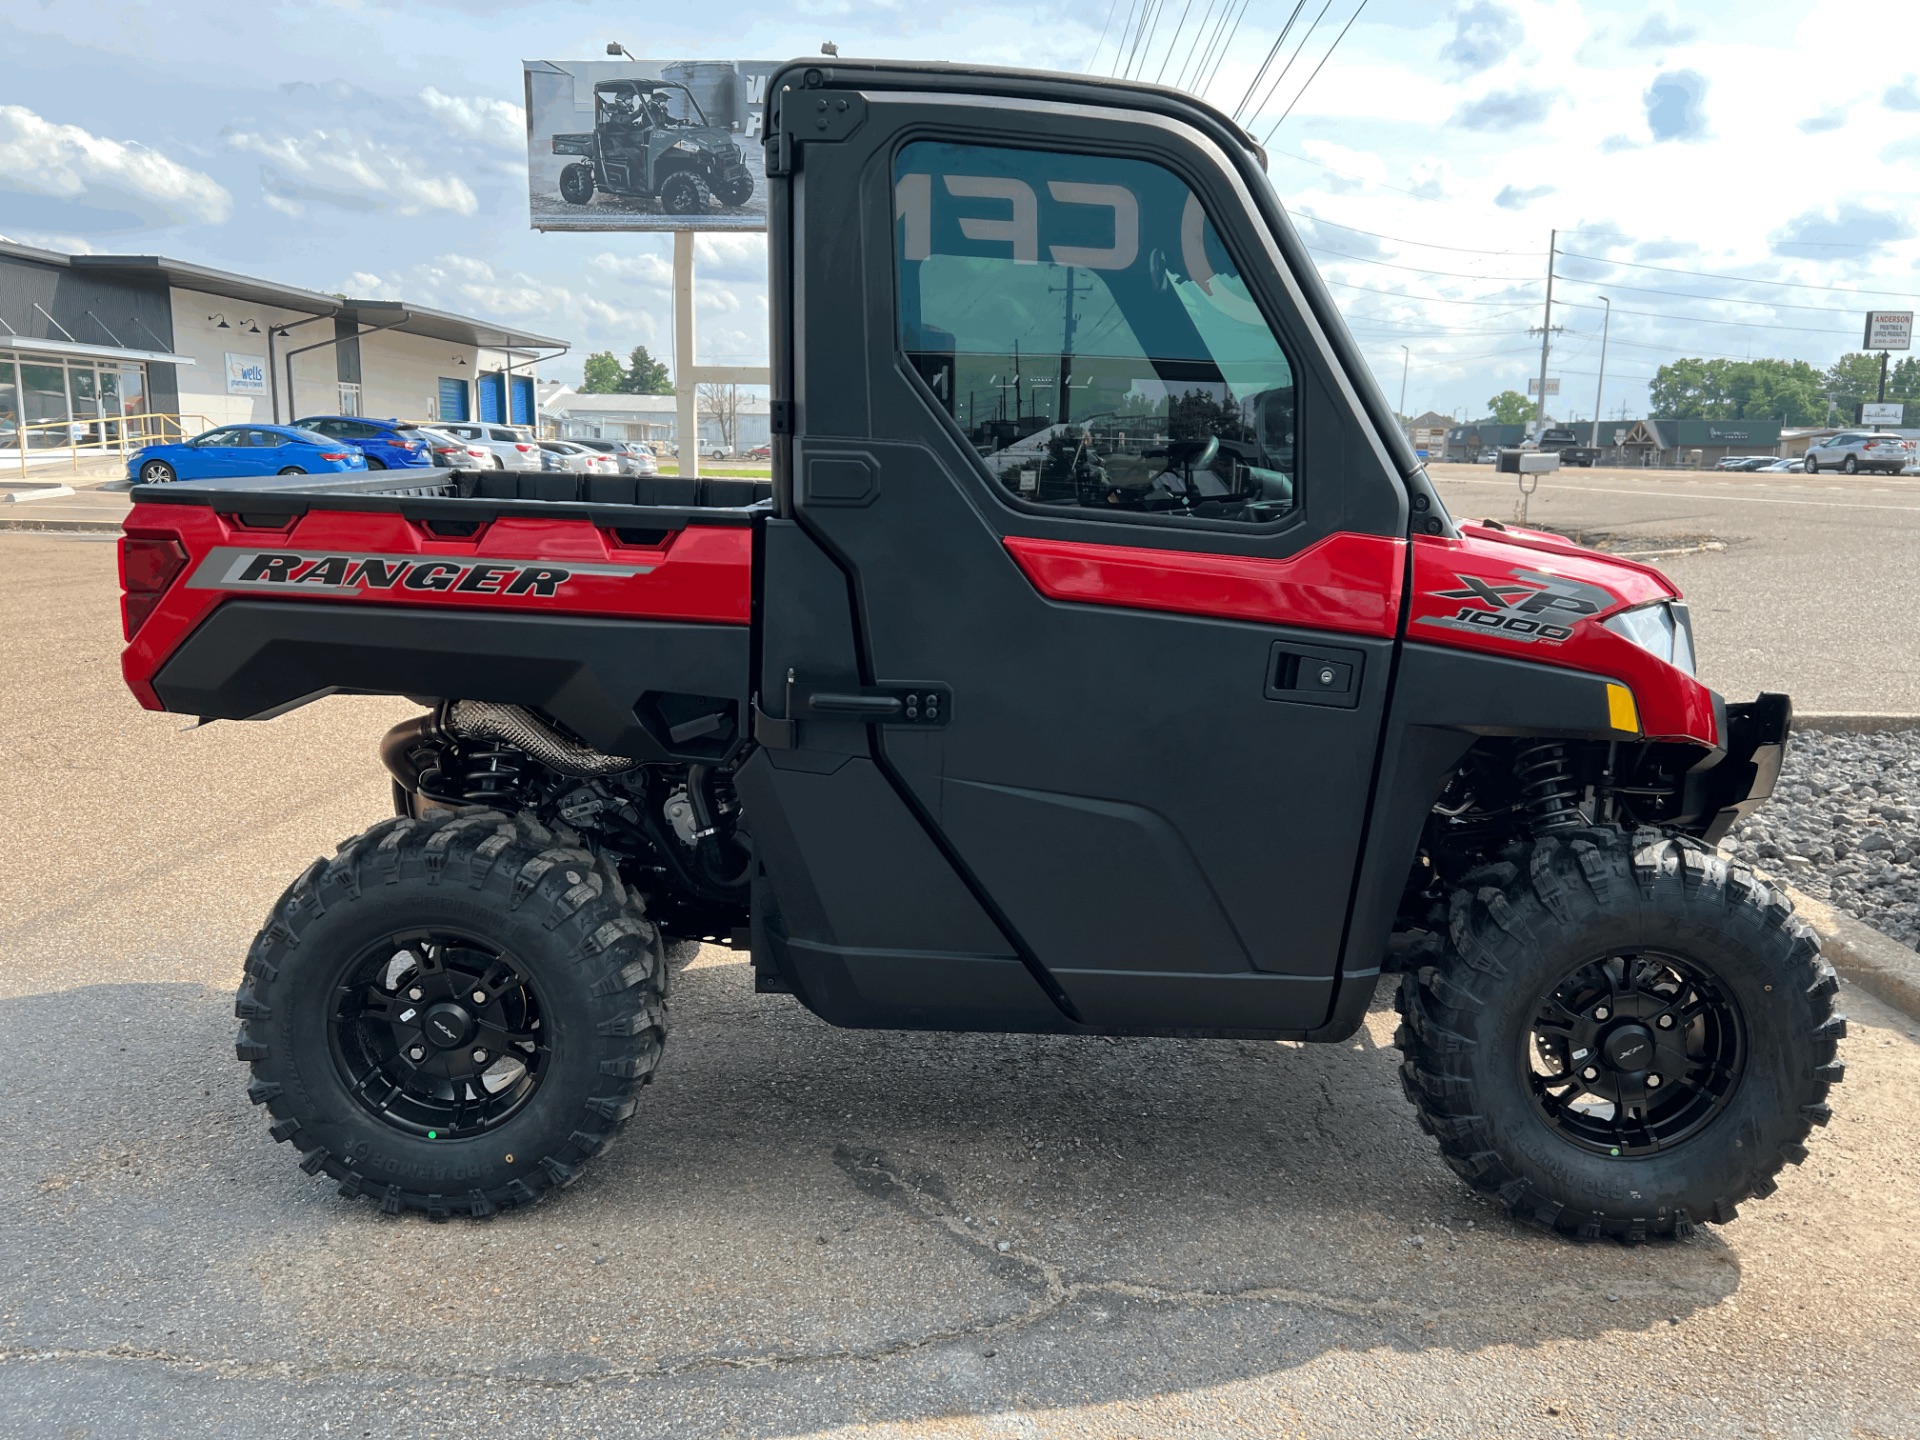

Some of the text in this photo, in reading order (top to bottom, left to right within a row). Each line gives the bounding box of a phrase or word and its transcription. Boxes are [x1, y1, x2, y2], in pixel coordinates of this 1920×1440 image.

[1875, 315, 1910, 323] ANDERSON
[242, 366, 262, 381] wells
[238, 552, 571, 598] RANGER
[1426, 574, 1602, 616] XP
[1455, 607, 1575, 641] 1000
[1450, 623, 1480, 633] DUAL
[1538, 639, 1563, 647] CAM
[433, 1020, 457, 1039] XP
[1619, 1044, 1645, 1060] XP
